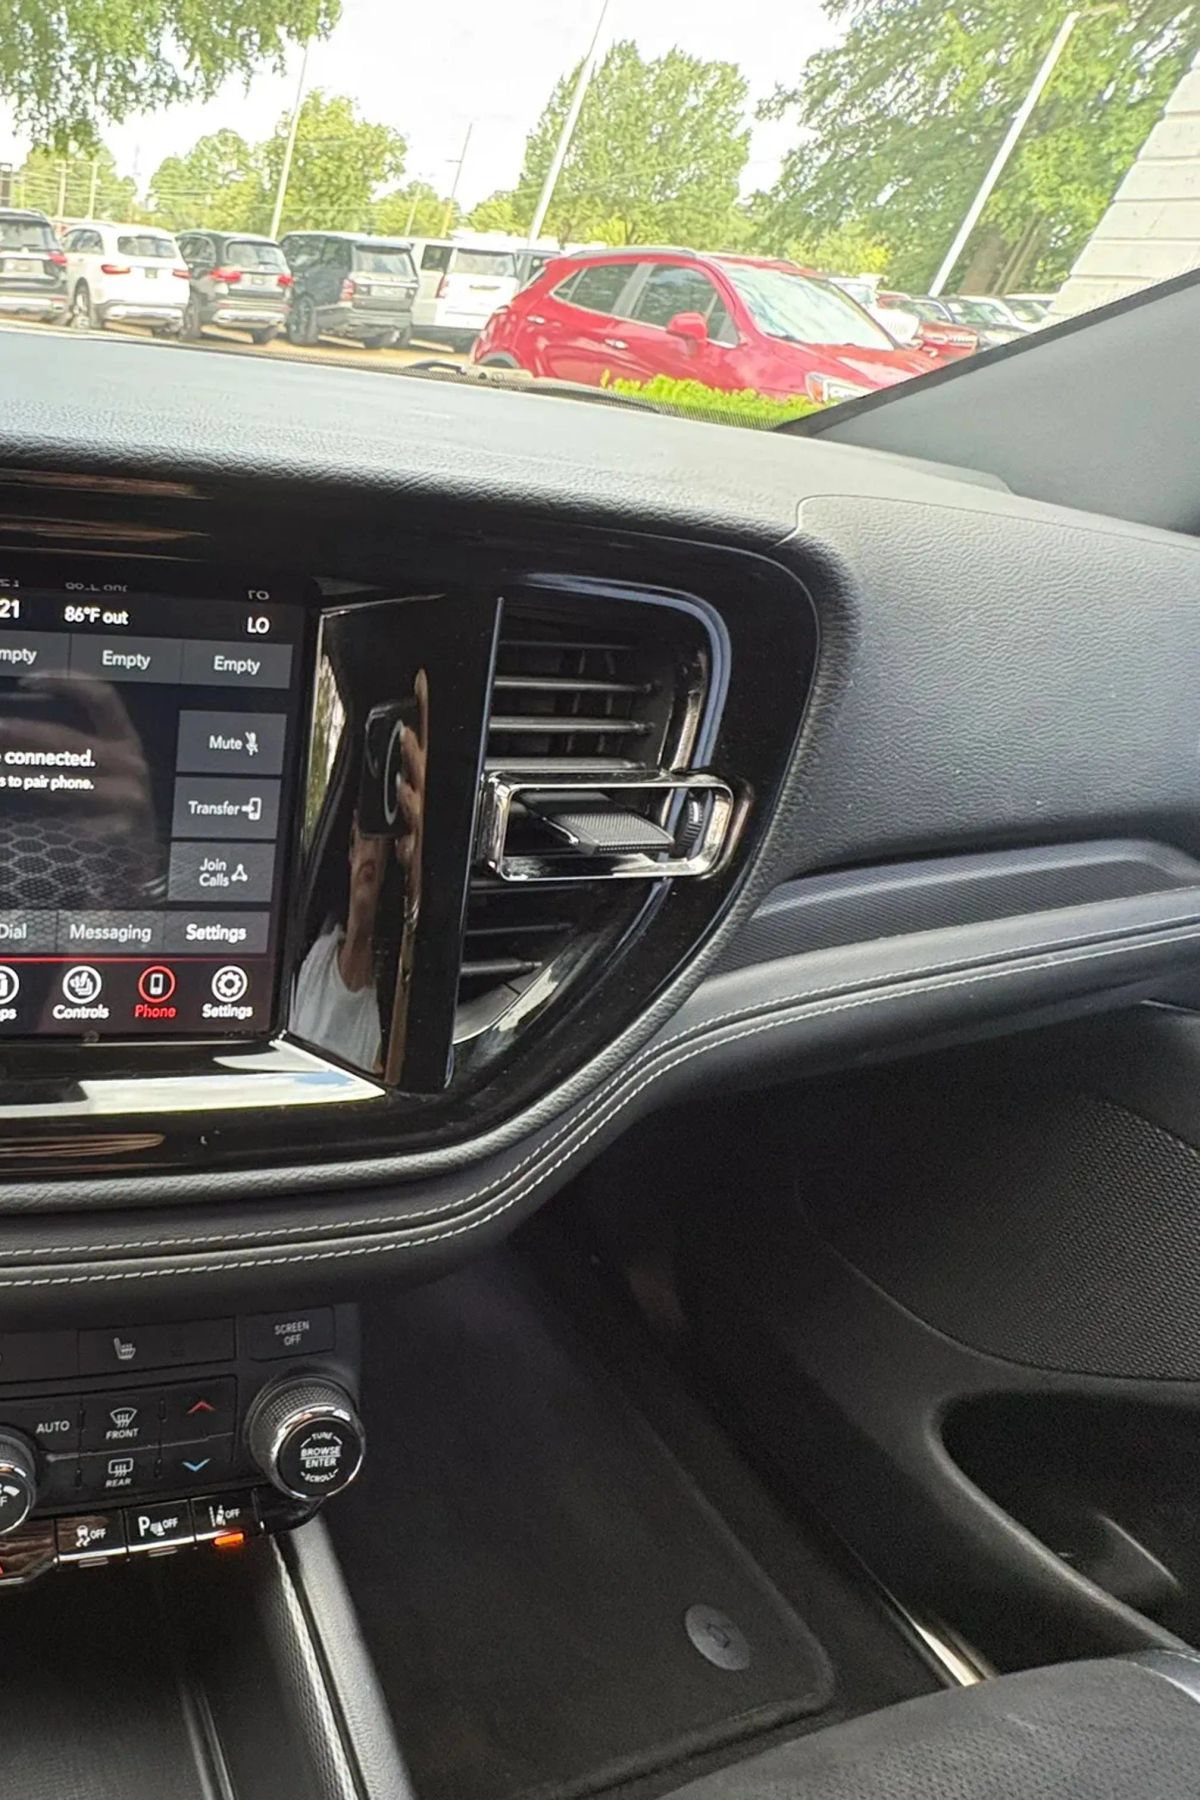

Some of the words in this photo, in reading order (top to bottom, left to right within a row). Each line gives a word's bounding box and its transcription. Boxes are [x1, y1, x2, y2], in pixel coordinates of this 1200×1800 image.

[64, 605, 100, 623] 86°F
[102, 610, 129, 626] out
[247, 617, 270, 634] LO
[102, 650, 151, 670] Empty
[214, 655, 261, 675] Empty
[209, 735, 243, 750] Mute
[5, 749, 96, 767] connected.
[8, 775, 23, 788] to
[24, 776, 49, 790] pair
[51, 775, 94, 791] phone.
[188, 800, 240, 815] Transfer
[199, 858, 227, 871] Join
[199, 873, 229, 887] Calls
[70, 924, 152, 943] Messaging
[186, 924, 247, 944] Settings
[52, 1004, 110, 1020] Controls
[134, 1004, 176, 1018] Phone
[202, 1004, 253, 1020] Settings
[274, 1320, 309, 1335] SCREEN
[283, 1334, 302, 1346] OFF
[36, 1421, 70, 1433] AUTO
[106, 1428, 139, 1440] FRONT
[311, 1432, 333, 1440] TUNE
[300, 1446, 341, 1457] BROWSE
[305, 1457, 337, 1468] ENTER
[106, 1478, 132, 1488] REAR
[304, 1472, 335, 1483] SCROLL
[225, 1508, 240, 1519] OFF
[162, 1518, 178, 1528] OFF
[91, 1528, 106, 1541] OFF
